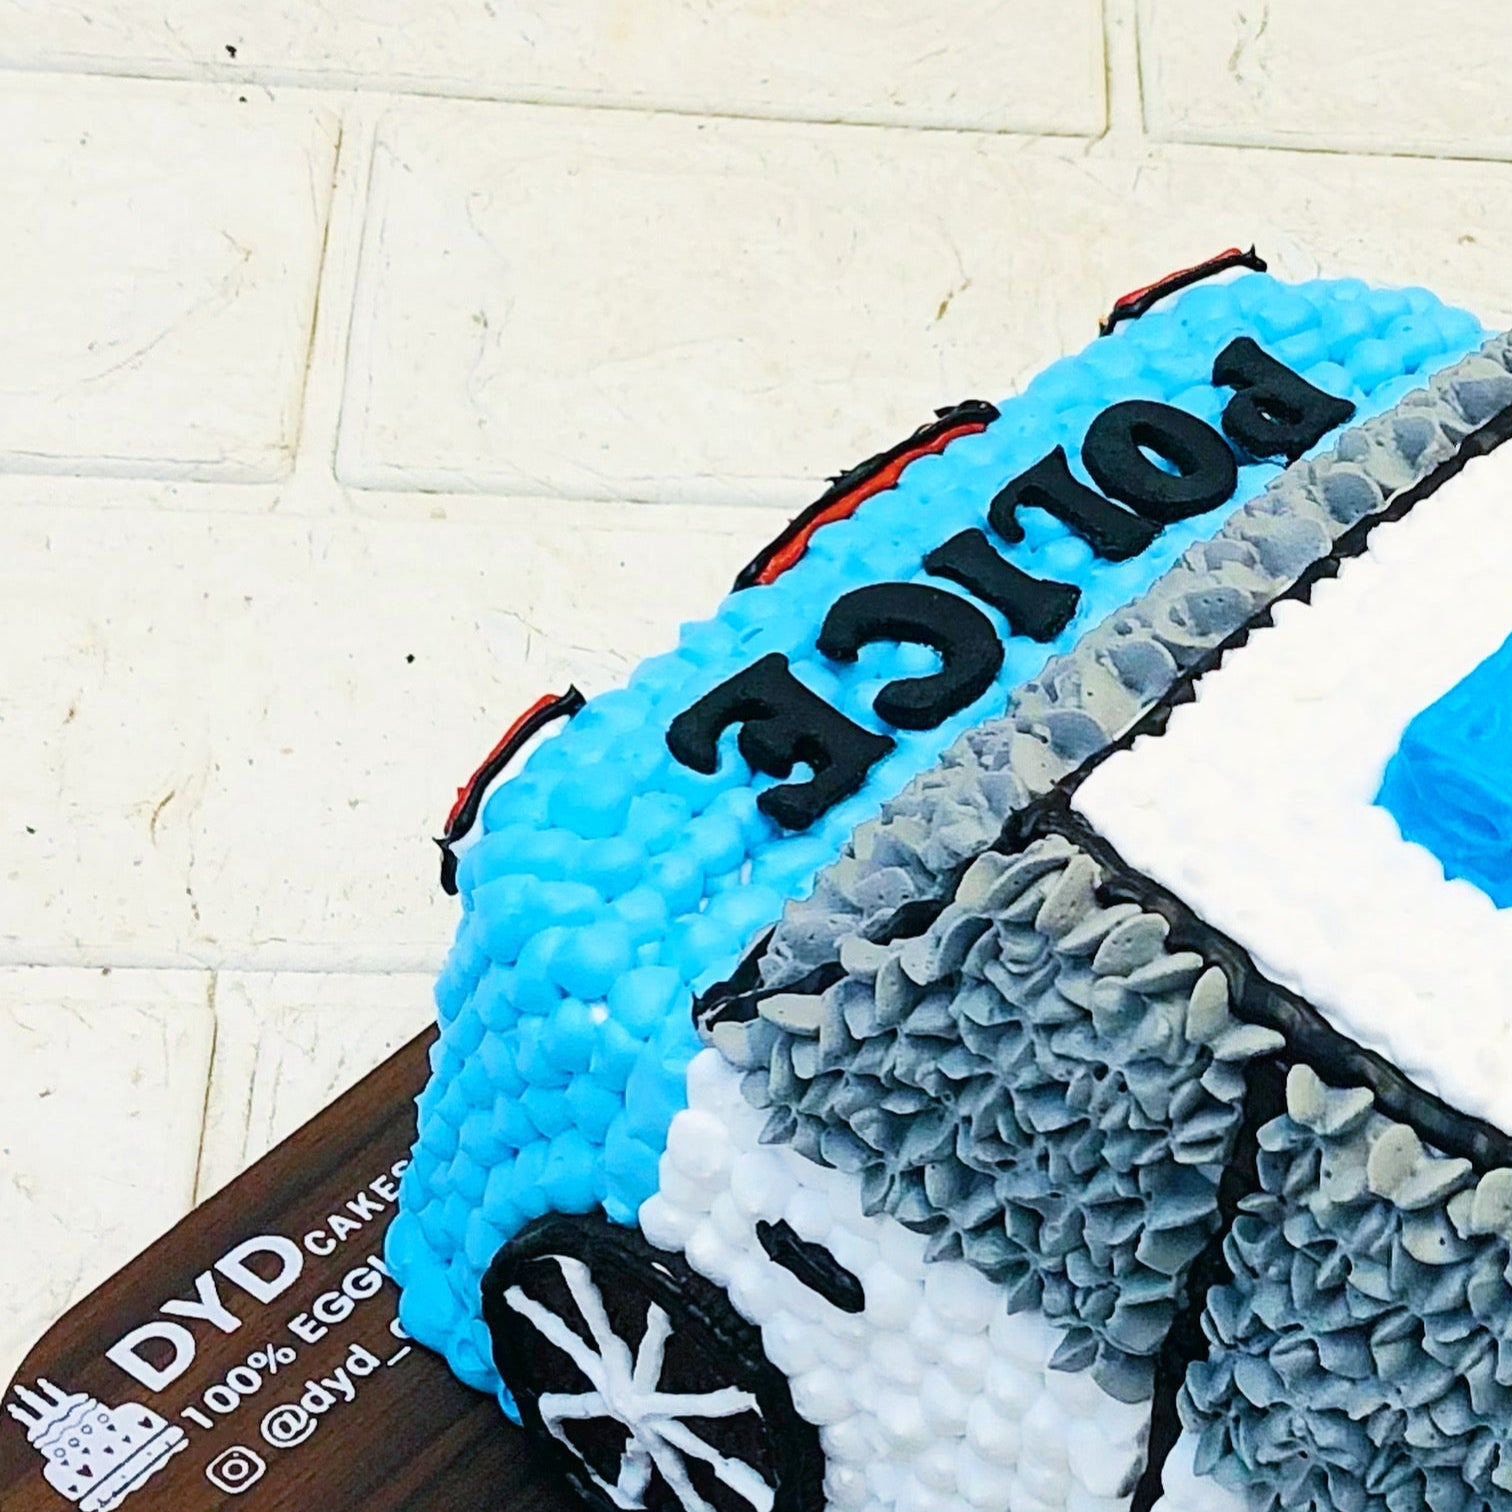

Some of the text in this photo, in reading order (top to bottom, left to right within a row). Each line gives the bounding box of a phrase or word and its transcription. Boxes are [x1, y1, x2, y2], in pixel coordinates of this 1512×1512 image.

[665, 336, 1357, 831] POLICE
[105, 1235, 304, 1392] DYD
[181, 1343, 296, 1428] 100%
